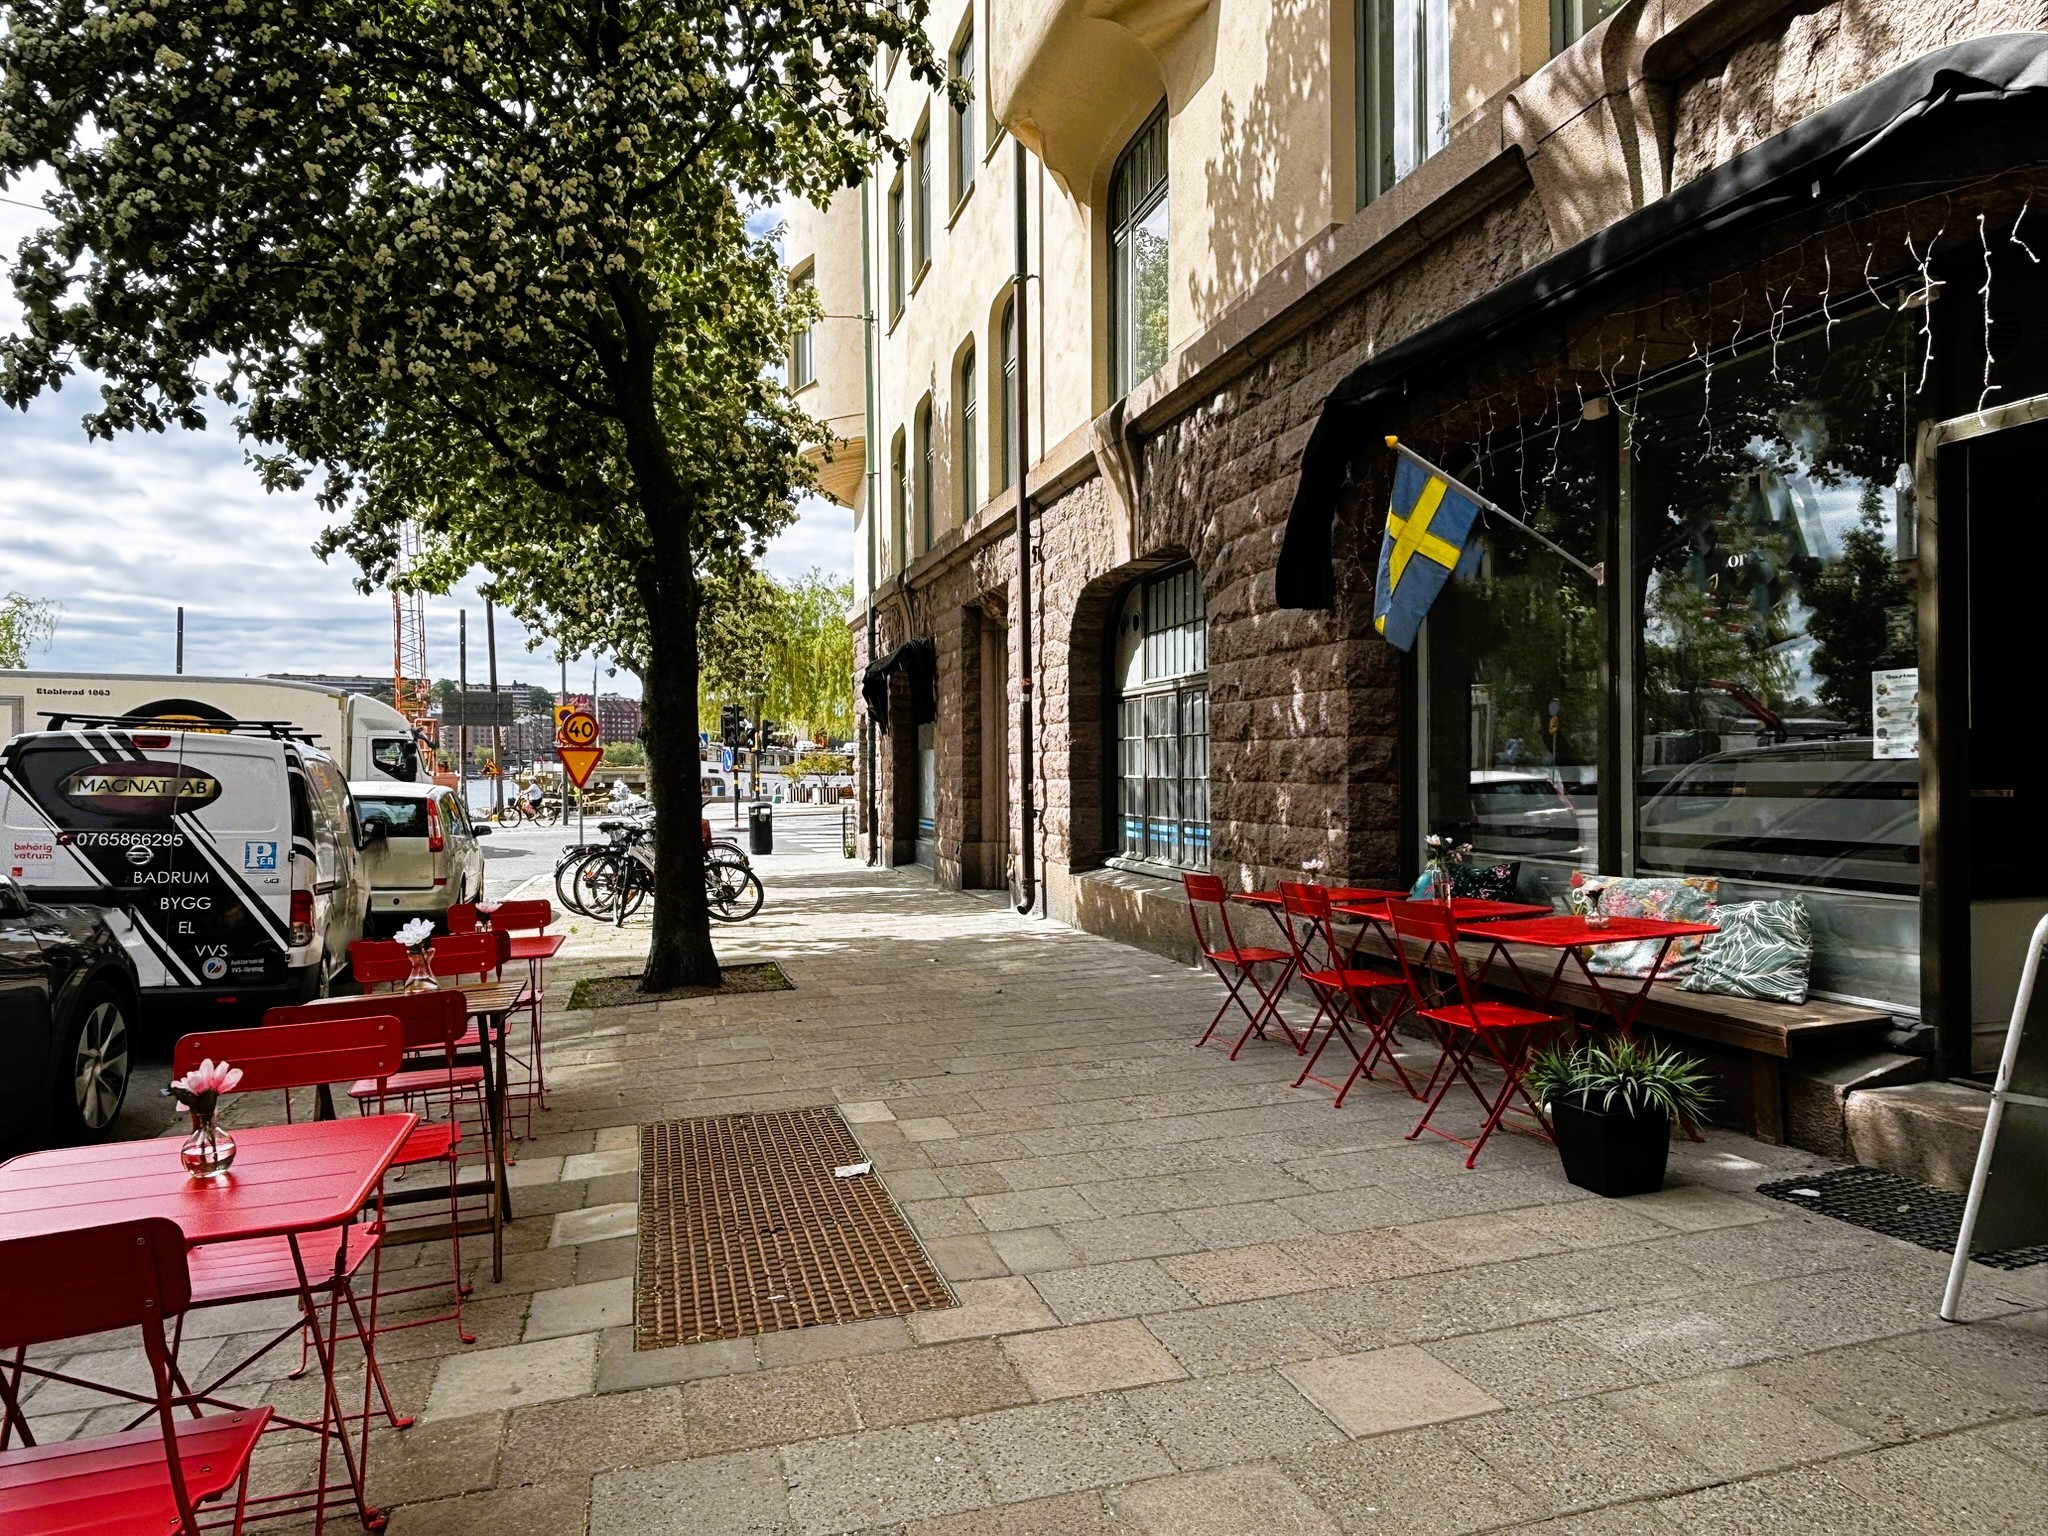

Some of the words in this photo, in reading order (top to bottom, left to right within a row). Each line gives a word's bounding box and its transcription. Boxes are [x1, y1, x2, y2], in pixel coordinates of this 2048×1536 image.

[36, 687, 85, 696] Etablerad
[568, 720, 593, 737] 40
[77, 779, 171, 793] MAGNAT
[179, 780, 207, 795] AB
[76, 832, 184, 847] 0765866295
[133, 871, 210, 884] BADRUM
[160, 896, 212, 910] BYGG
[178, 921, 196, 934] EL
[194, 944, 229, 957] VVS
